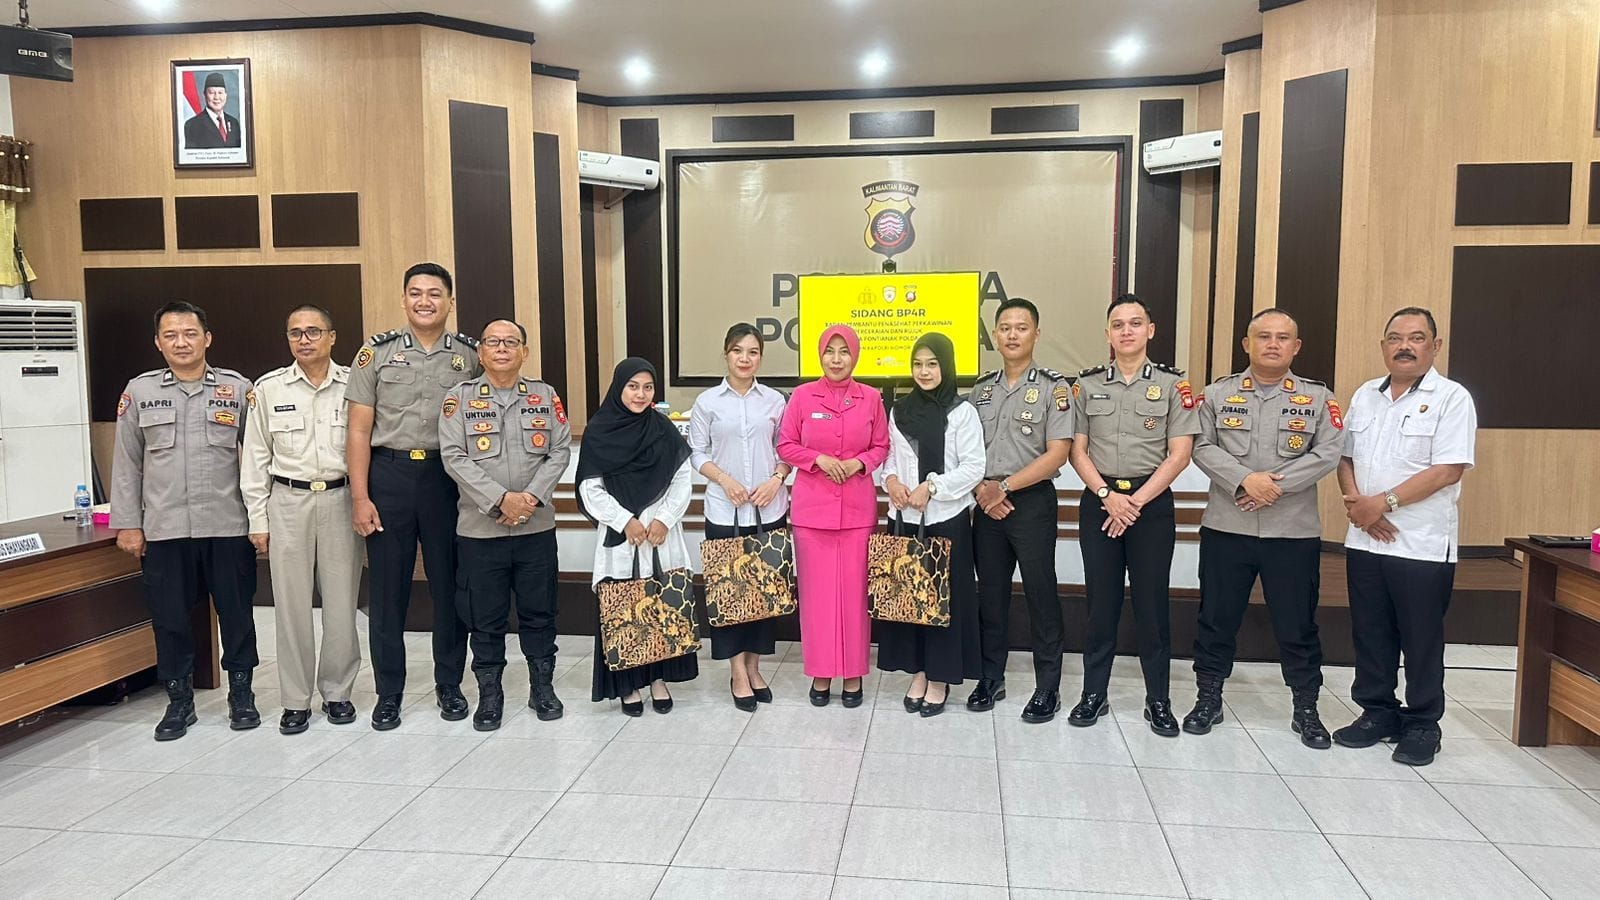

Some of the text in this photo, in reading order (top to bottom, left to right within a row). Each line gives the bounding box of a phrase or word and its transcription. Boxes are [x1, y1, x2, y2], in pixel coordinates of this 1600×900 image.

[866, 183, 915, 194] KALIMANTAN BARAT
[851, 308, 926, 318] SIDANG BP4R
[140, 399, 239, 409] SAPRI POLRI
[465, 407, 550, 420] UNTUNG POLRI
[1220, 405, 1315, 417] JUBAEDI POLRI
